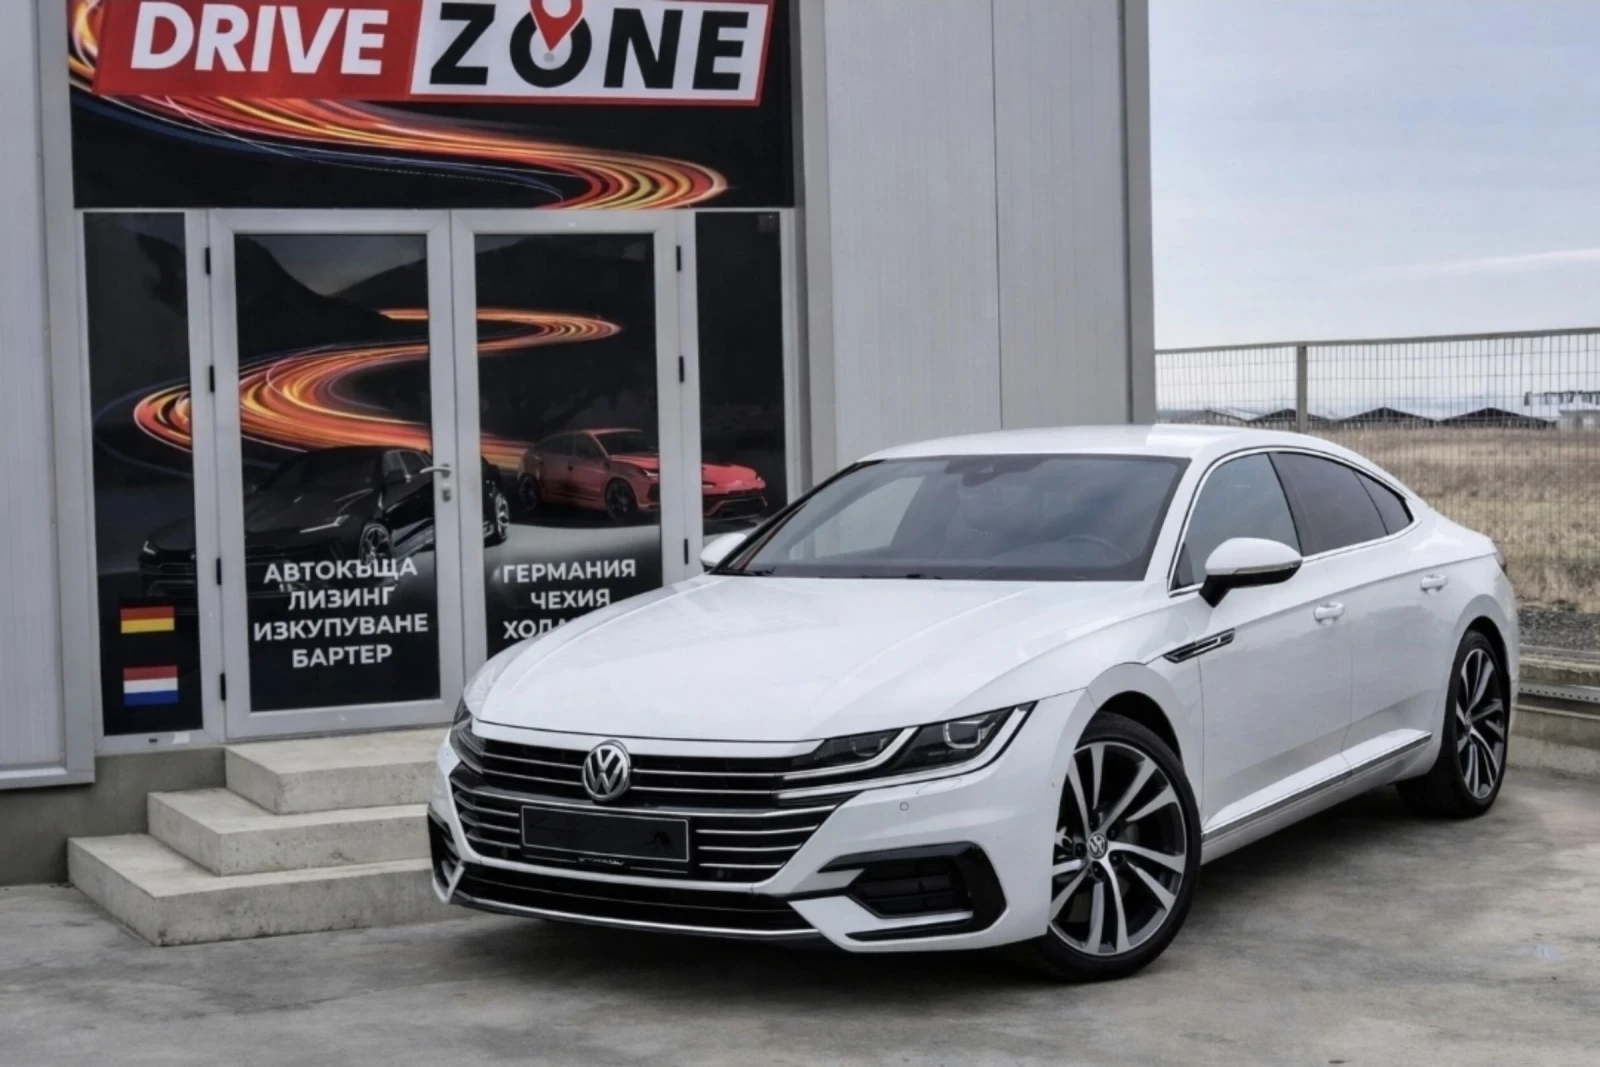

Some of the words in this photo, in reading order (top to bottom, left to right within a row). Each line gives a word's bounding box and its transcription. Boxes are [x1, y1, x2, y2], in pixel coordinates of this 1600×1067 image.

[130, 1, 389, 75] DRIVE
[429, 2, 749, 92] ZONE
[263, 557, 419, 584] АВТОКЪЩА
[502, 558, 636, 584] ГЕРМАНИЯ
[288, 586, 396, 612] ЛИЗИНГ
[530, 588, 611, 610] ЧЕХИЯ
[253, 613, 429, 642] ИЗКУПУВАНЕ
[291, 644, 393, 669] БАРТЕР
[584, 743, 629, 798] VW
